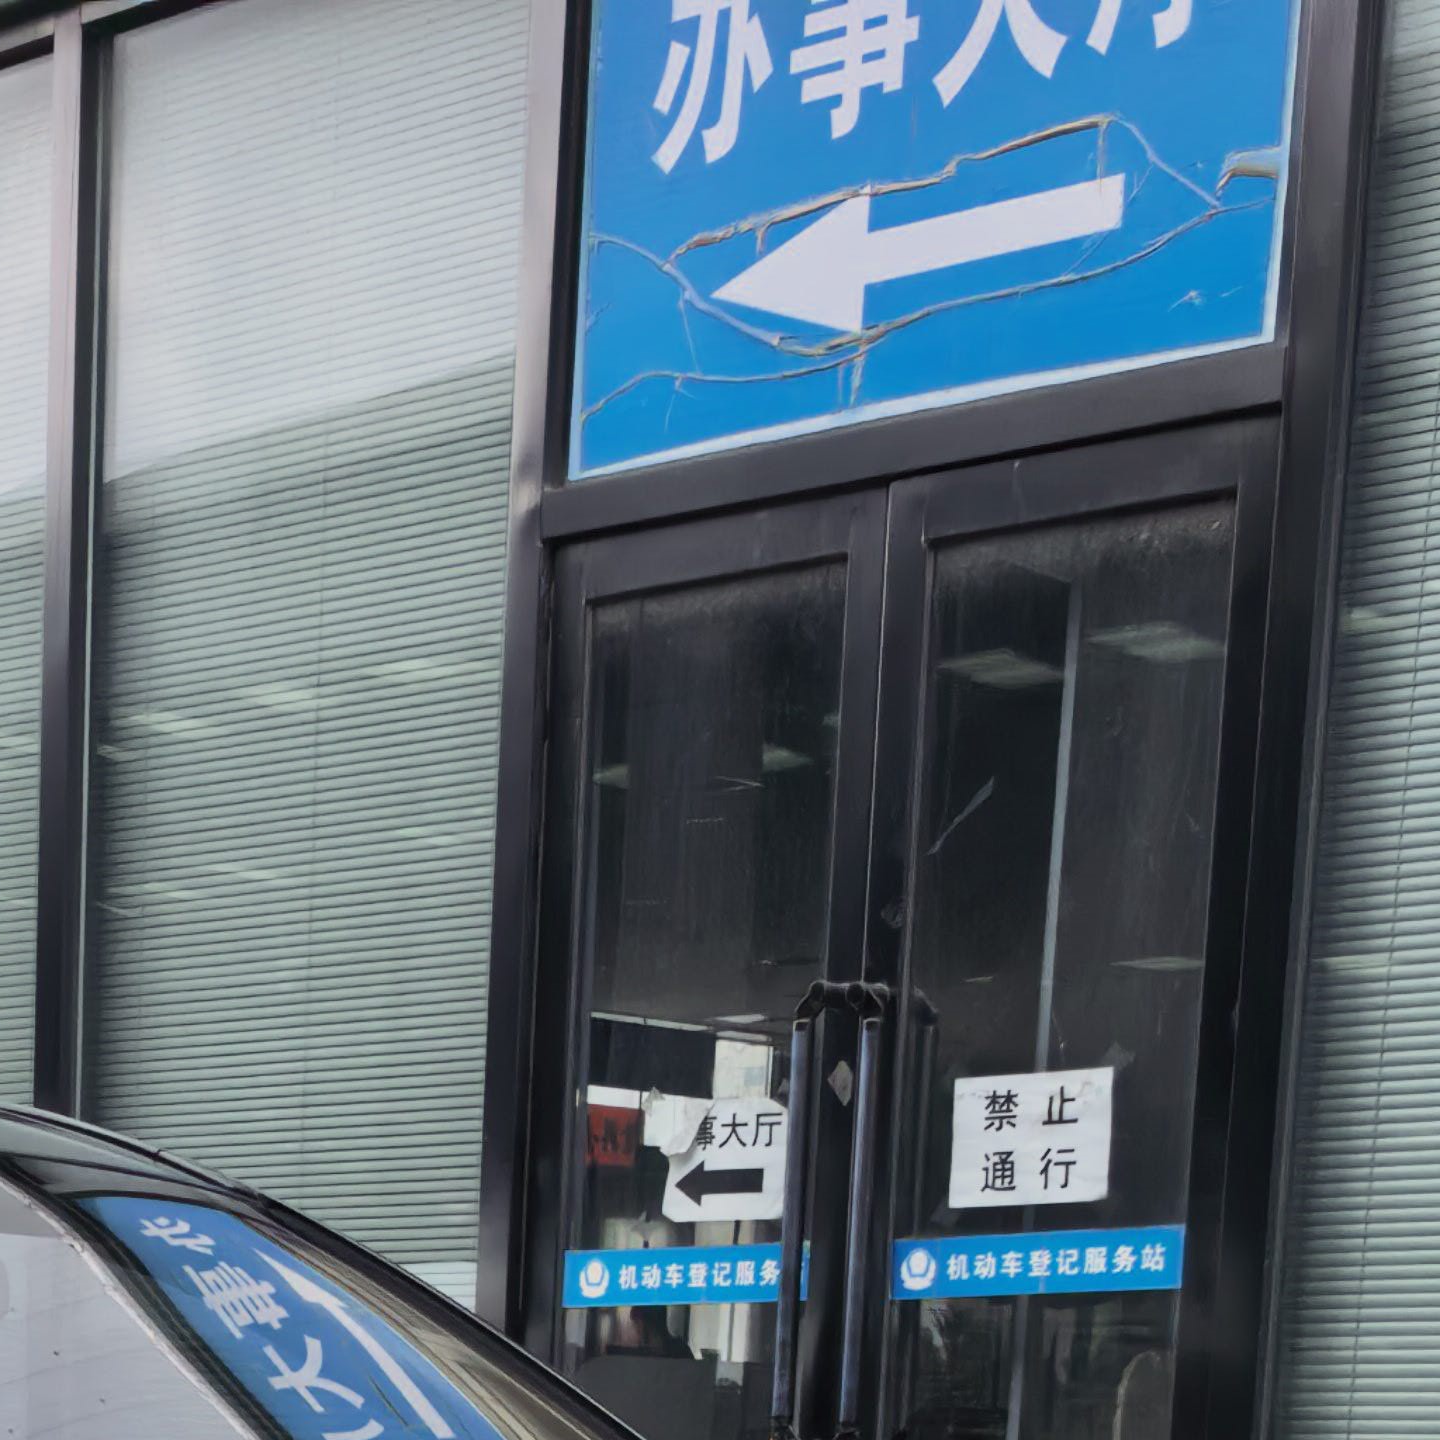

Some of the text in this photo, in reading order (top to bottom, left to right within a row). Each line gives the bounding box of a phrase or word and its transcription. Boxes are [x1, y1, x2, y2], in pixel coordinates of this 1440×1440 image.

[651, 0, 1192, 175] 办事
[983, 1085, 1079, 1132] 禁止
[980, 1147, 1077, 1192] 通行
[618, 1260, 782, 1289] 机动车登记服务
[946, 1243, 1167, 1281] 机动车登记服务站
